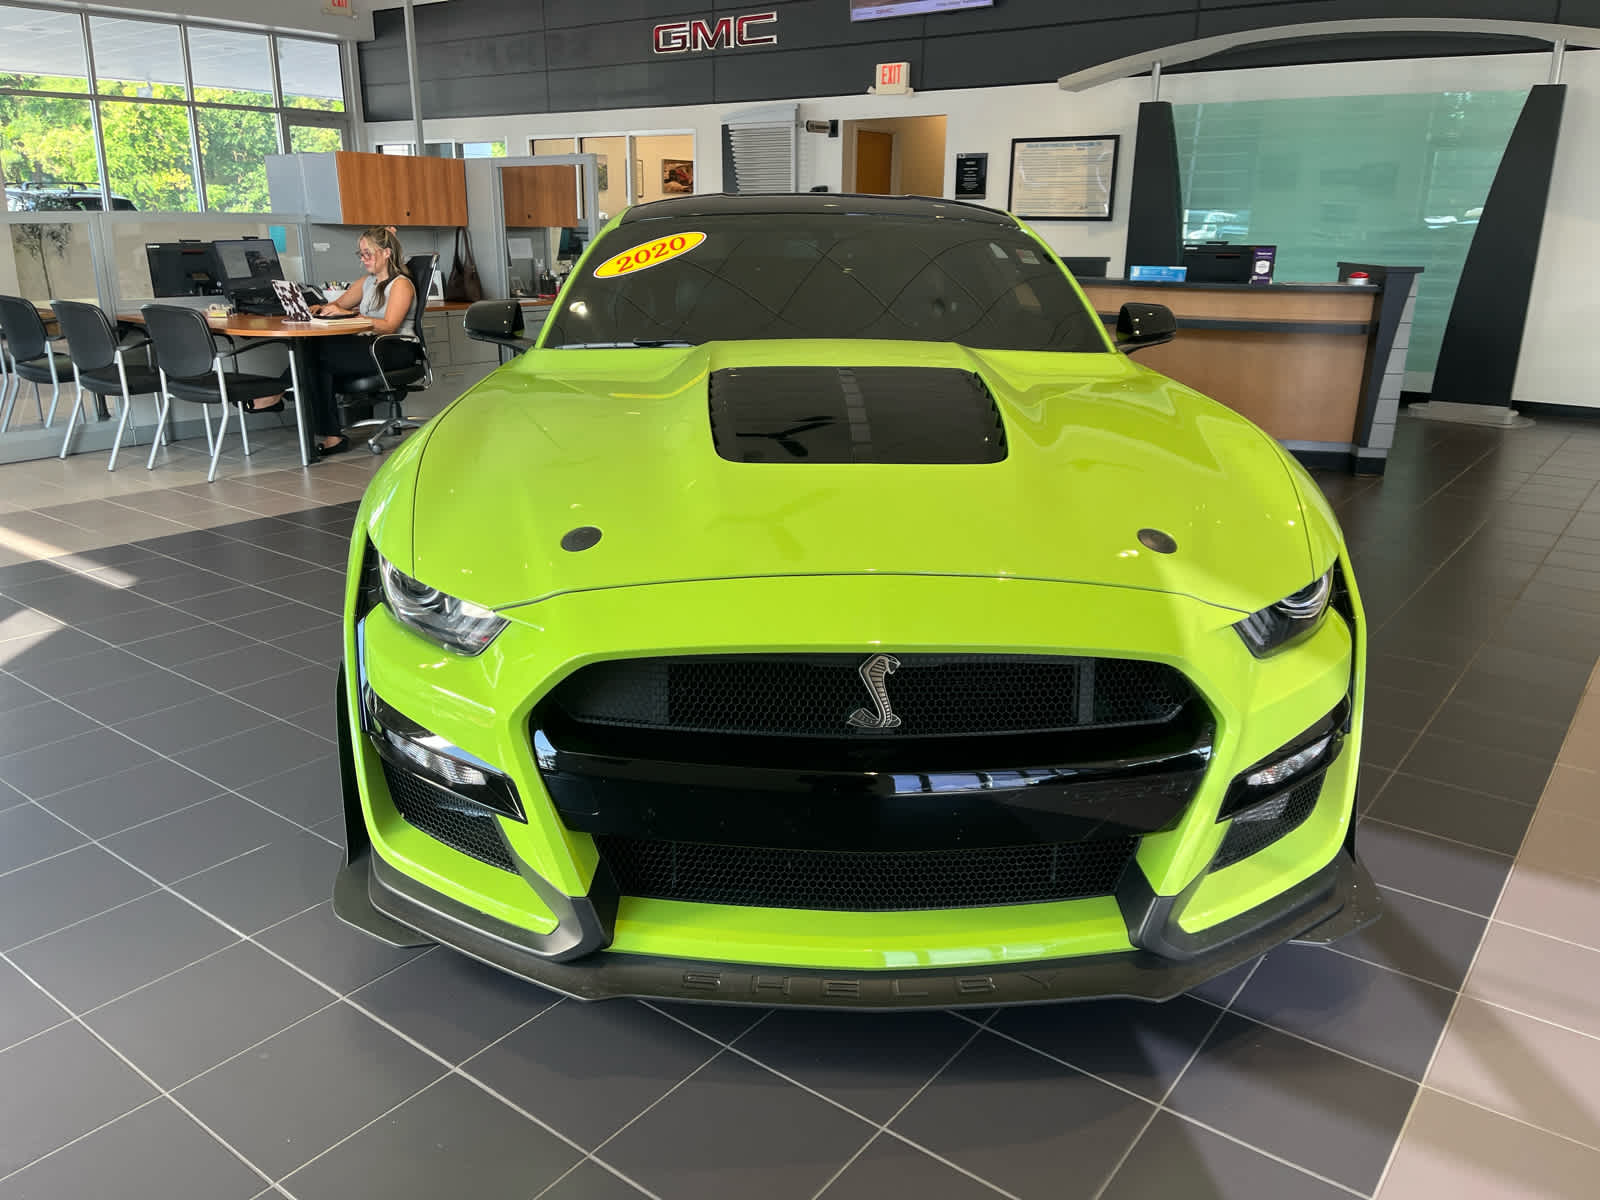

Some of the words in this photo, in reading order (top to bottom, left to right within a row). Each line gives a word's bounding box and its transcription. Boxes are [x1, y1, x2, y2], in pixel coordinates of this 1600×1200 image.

[653, 11, 777, 54] GMC
[881, 64, 902, 85] EXIT
[616, 236, 686, 272] 2020
[682, 971, 1059, 997] SHELBY
